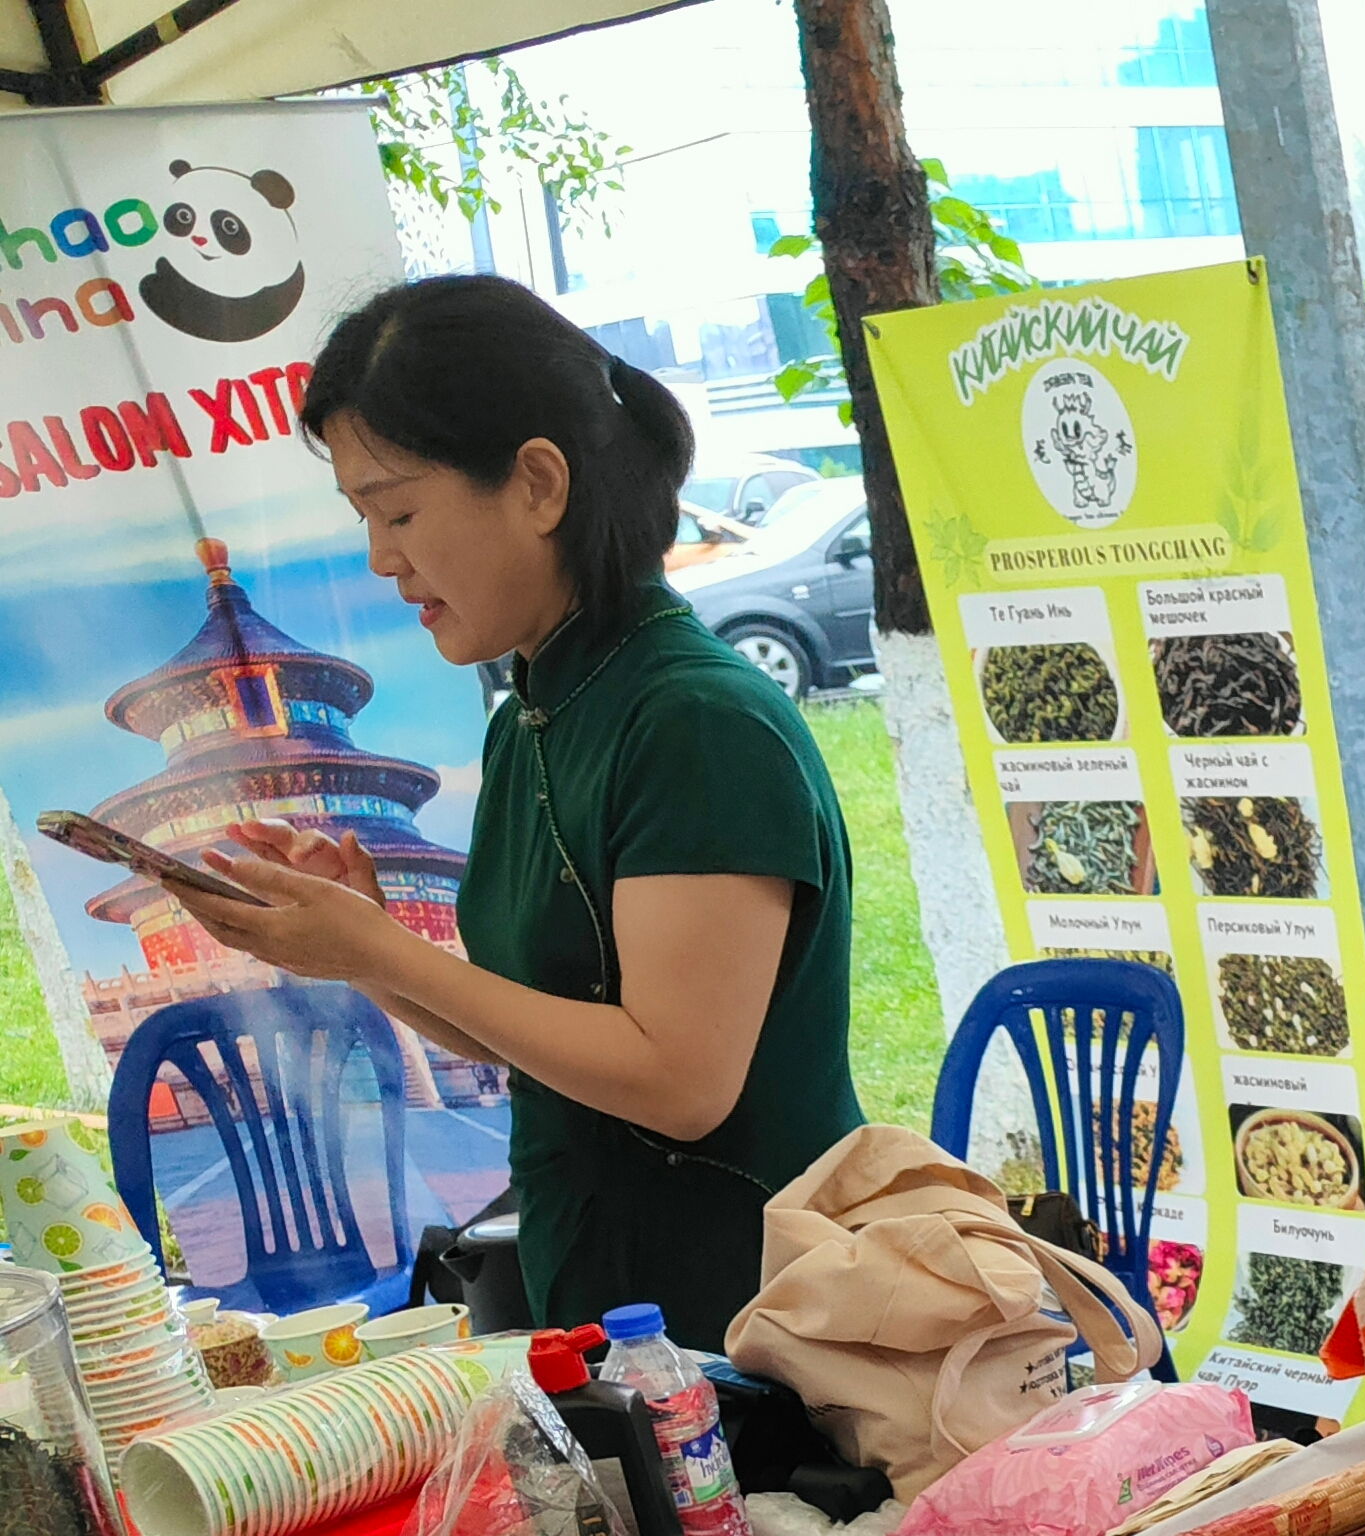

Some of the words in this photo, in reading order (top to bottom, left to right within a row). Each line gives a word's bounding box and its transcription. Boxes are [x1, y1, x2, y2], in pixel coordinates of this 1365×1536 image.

[953, 302, 1108, 400] КИТАЙСКИЙ
[1112, 312, 1184, 375] ЧАЙ
[990, 545, 1107, 572] PROSPEROUS
[1109, 537, 1227, 563] TONGCHANG
[1146, 588, 1206, 607] Большой
[1208, 582, 1264, 604] красный
[989, 606, 1005, 622] Те
[1009, 604, 1045, 624] Гуань
[1149, 608, 1208, 625] мешочек
[999, 757, 1074, 773] жасминовый
[1077, 755, 1129, 772] зеленый
[1184, 751, 1232, 770] Черный
[1235, 752, 1259, 768] чай
[1184, 776, 1249, 790] жасмином
[1048, 914, 1109, 930] Молочный
[1207, 917, 1281, 936] Персиковый
[1232, 1073, 1308, 1092] жасминовый
[1273, 1218, 1335, 1242] Билуочунь
[1208, 1351, 1281, 1376] Китайский
[1223, 1373, 1259, 1392] Пуэр
